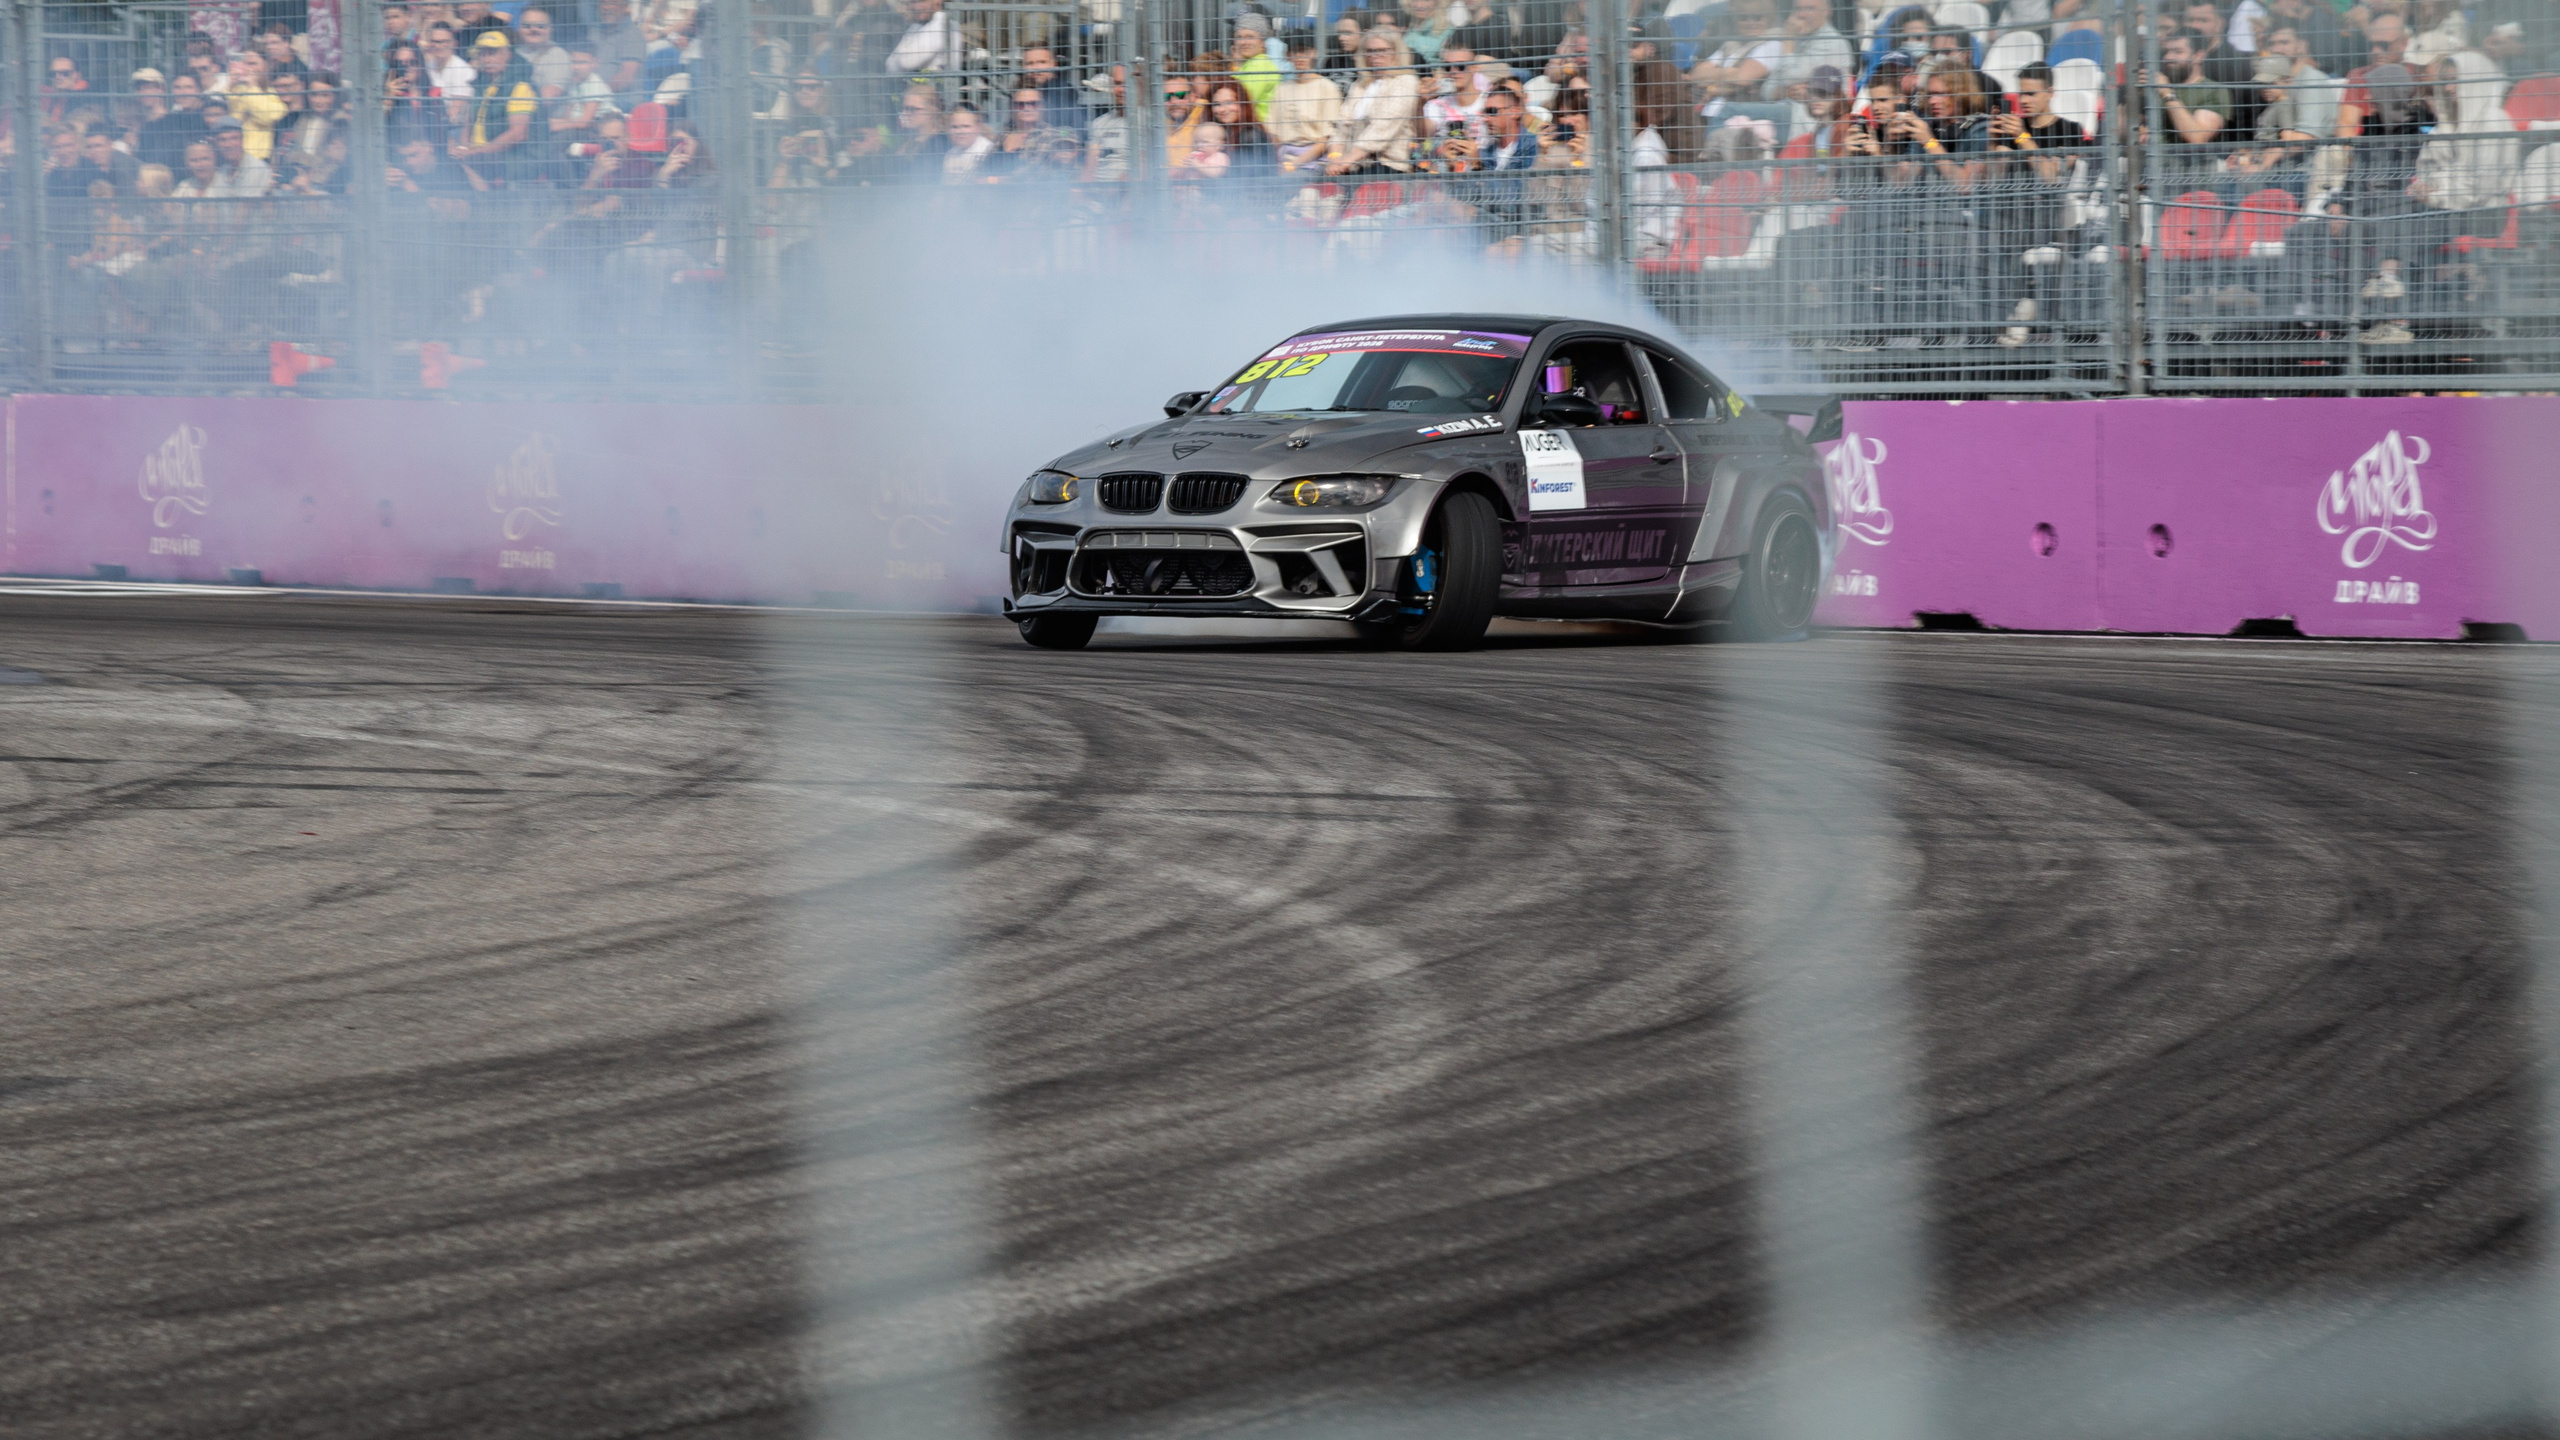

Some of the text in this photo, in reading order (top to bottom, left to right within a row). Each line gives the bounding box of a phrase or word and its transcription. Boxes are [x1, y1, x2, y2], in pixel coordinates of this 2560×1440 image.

[1236, 353, 1329, 385] 812
[1530, 478, 1574, 494] KINFOREST
[1529, 523, 1667, 564] ПИТЕРСКИЙ ЩИТ
[2333, 575, 2421, 605] ДРАЙВ
